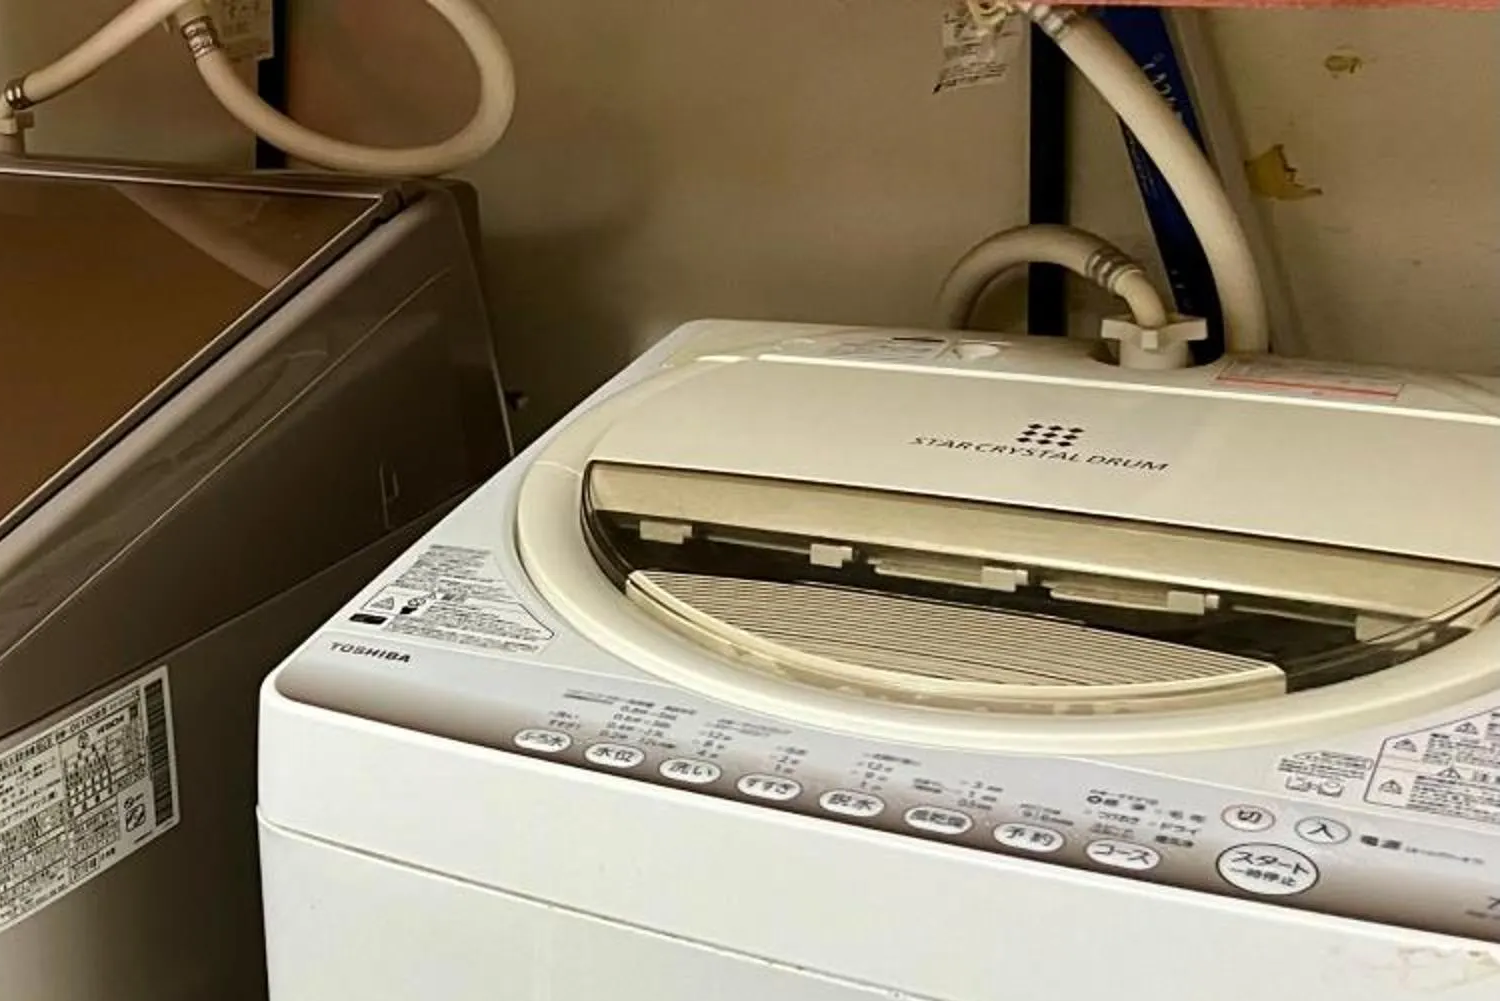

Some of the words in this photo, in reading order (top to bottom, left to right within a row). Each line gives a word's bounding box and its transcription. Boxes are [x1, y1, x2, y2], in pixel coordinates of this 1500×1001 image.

[912, 434, 971, 450] STAR
[974, 441, 1080, 463] CRYSTAL
[1085, 452, 1169, 472] DRUM
[329, 641, 411, 664] TOSHIBA
[1306, 822, 1335, 840] 入
[1093, 842, 1151, 865] コース
[1231, 850, 1310, 876] スタート
